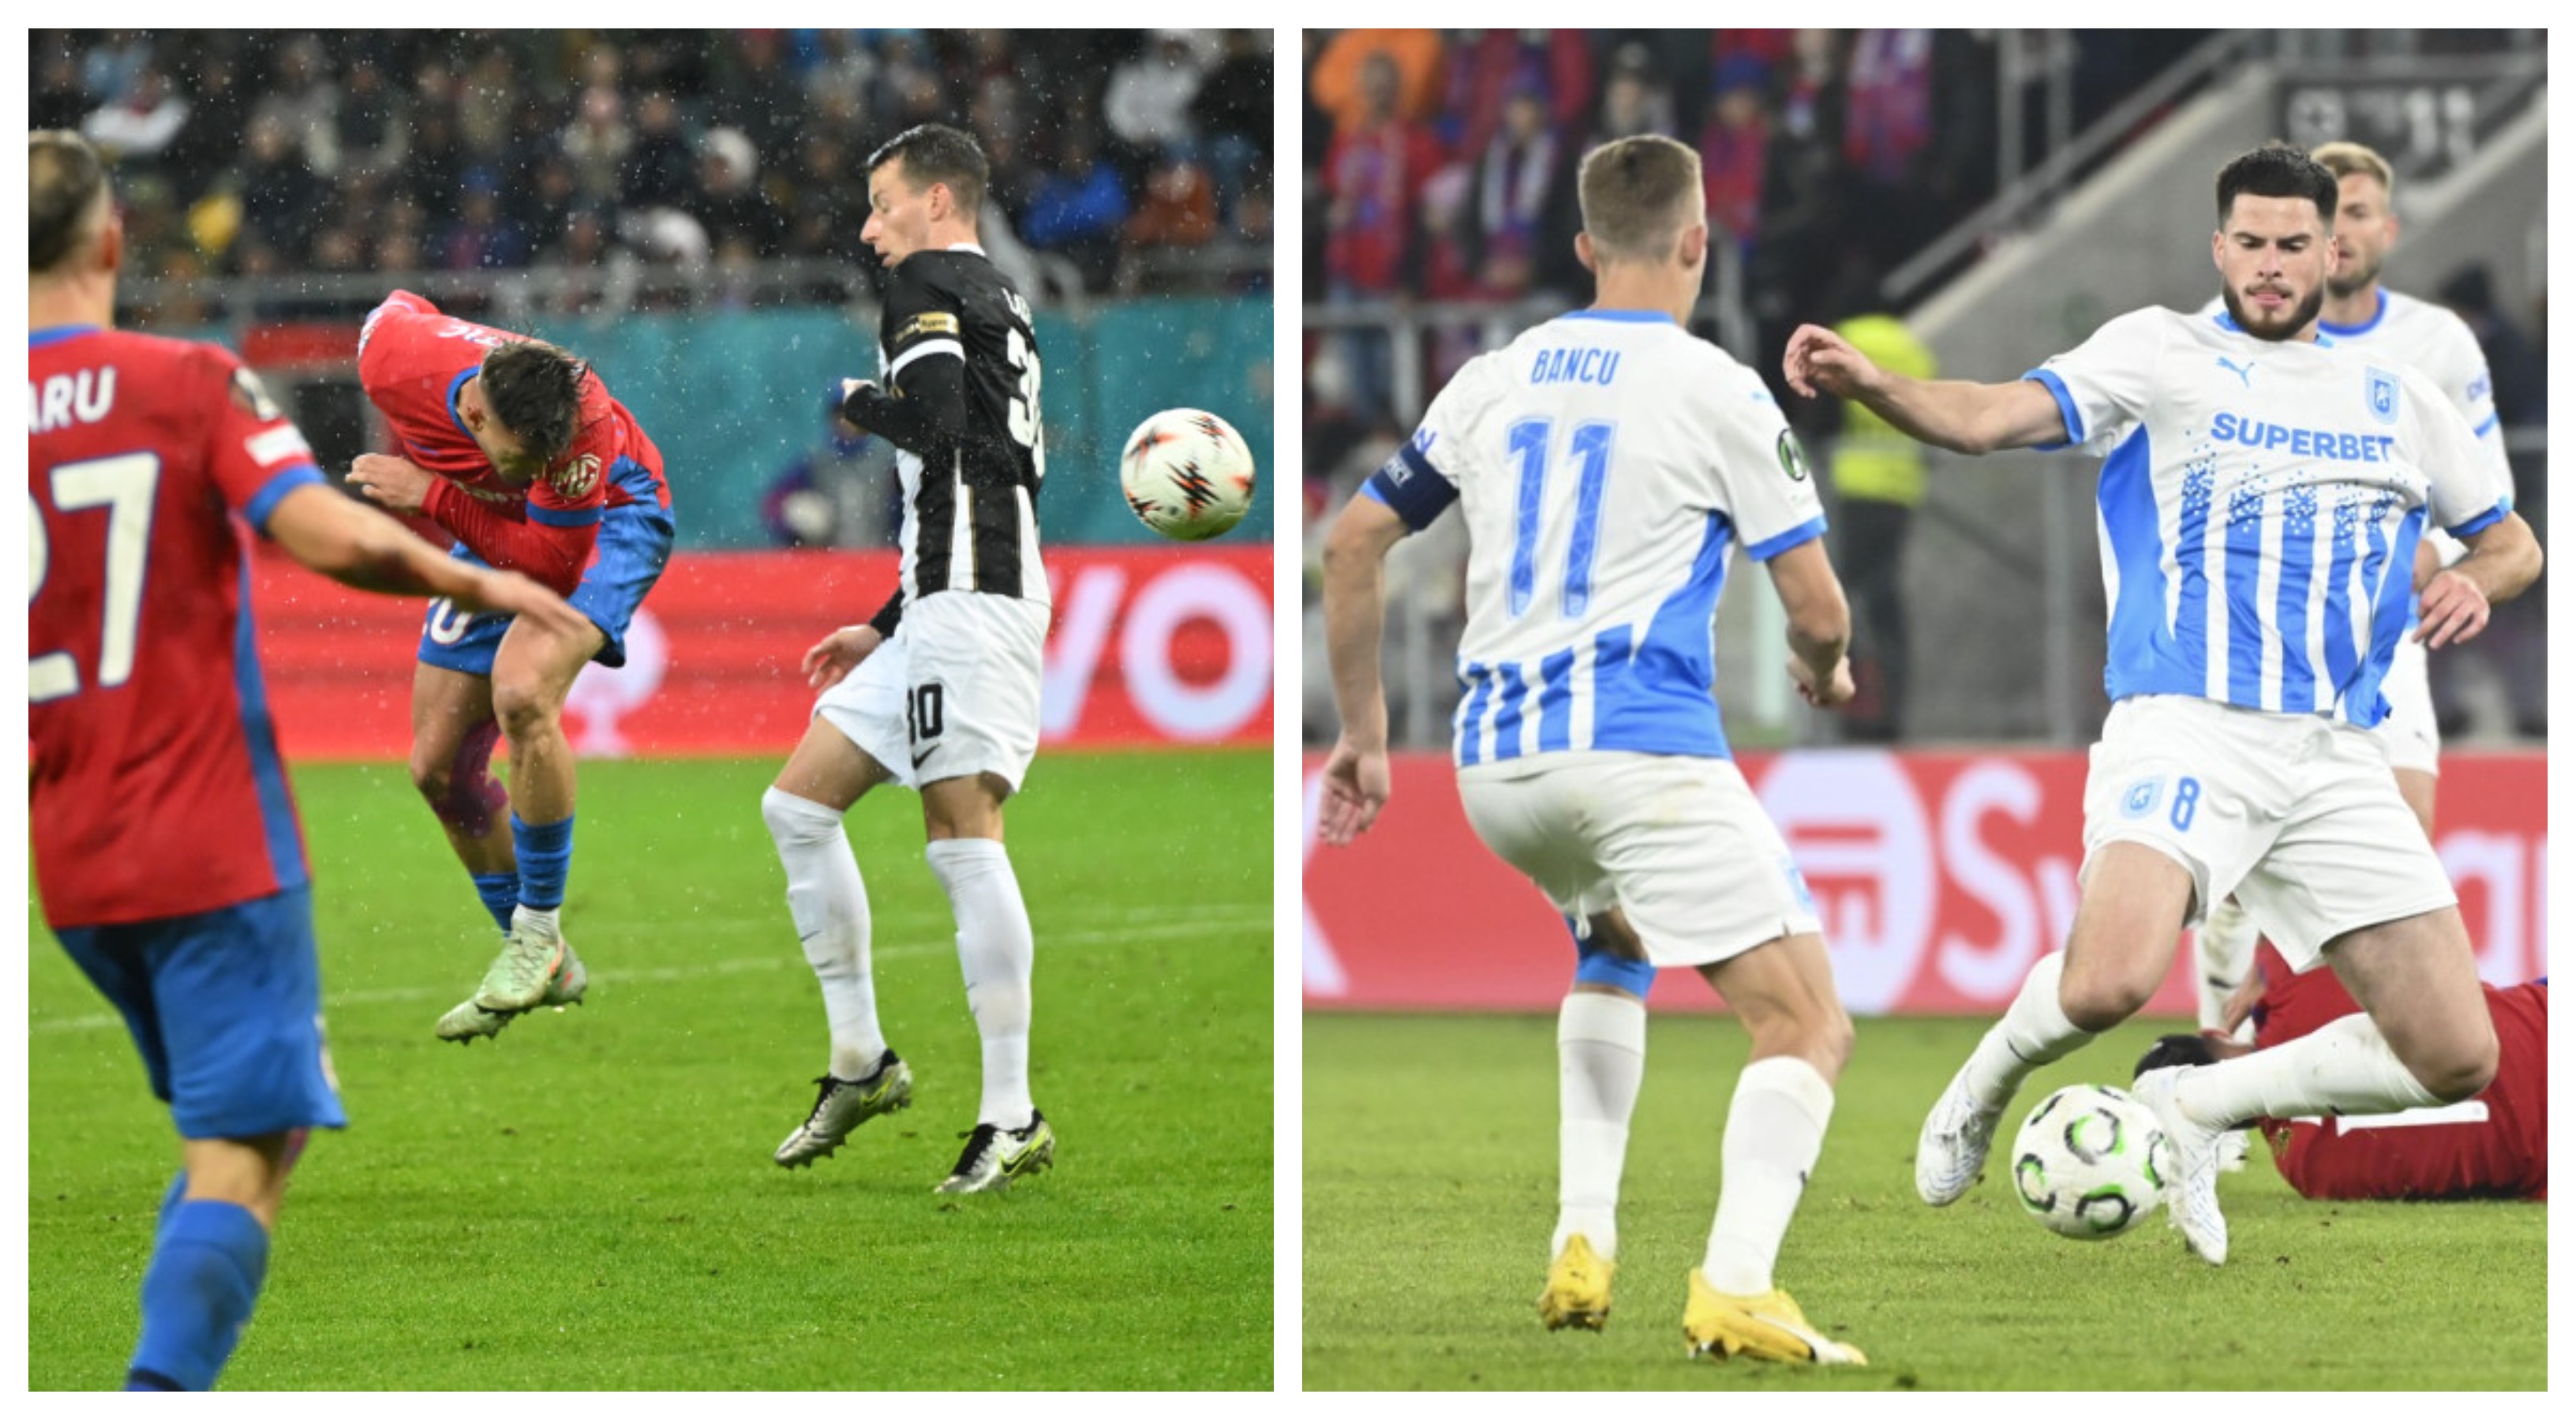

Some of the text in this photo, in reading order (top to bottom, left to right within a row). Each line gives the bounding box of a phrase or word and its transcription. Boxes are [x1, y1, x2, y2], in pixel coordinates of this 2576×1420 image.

[1530, 348, 1620, 384] BANCU
[2211, 411, 2394, 462] SUPERBET
[1504, 415, 1617, 621] 11
[2170, 776, 2200, 832] 8
